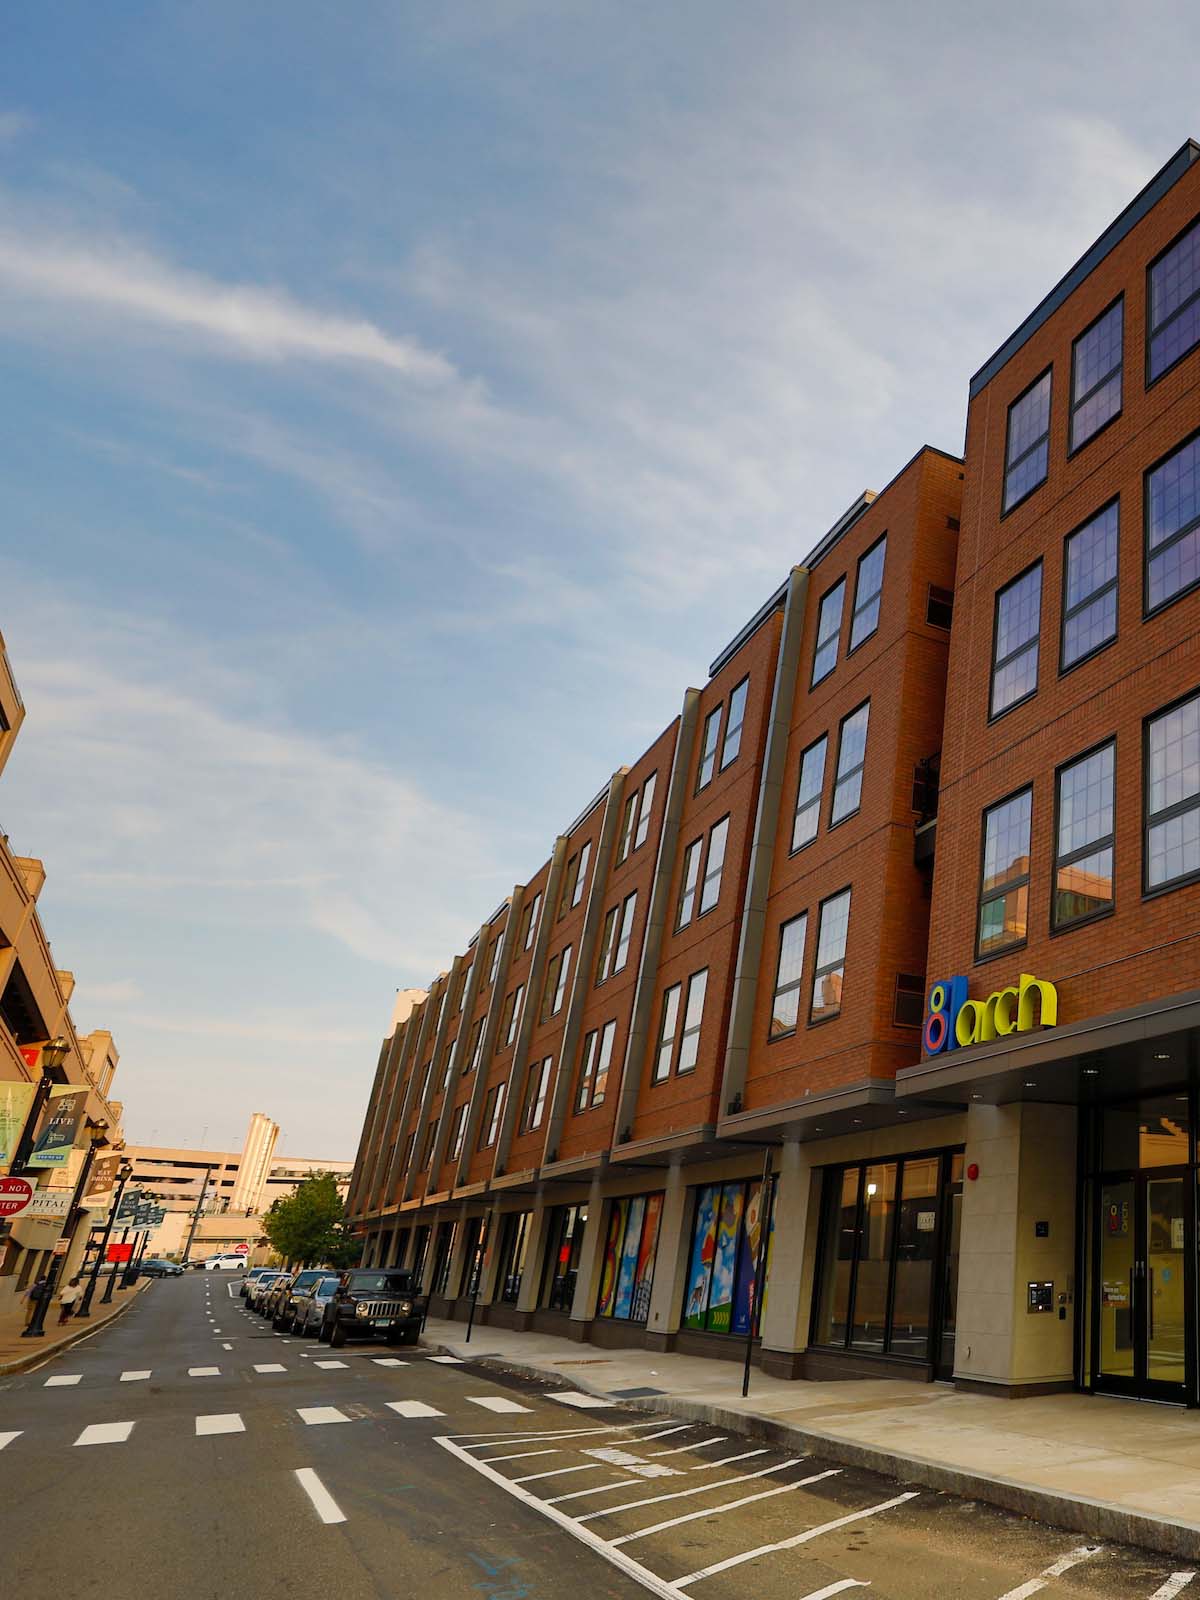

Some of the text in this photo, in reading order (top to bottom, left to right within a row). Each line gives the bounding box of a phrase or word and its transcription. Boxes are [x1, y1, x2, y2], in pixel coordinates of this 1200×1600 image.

[48, 1117, 75, 1126] LIVE
[0, 1202, 18, 1210] TER
[32, 1199, 65, 1207] PITAL
